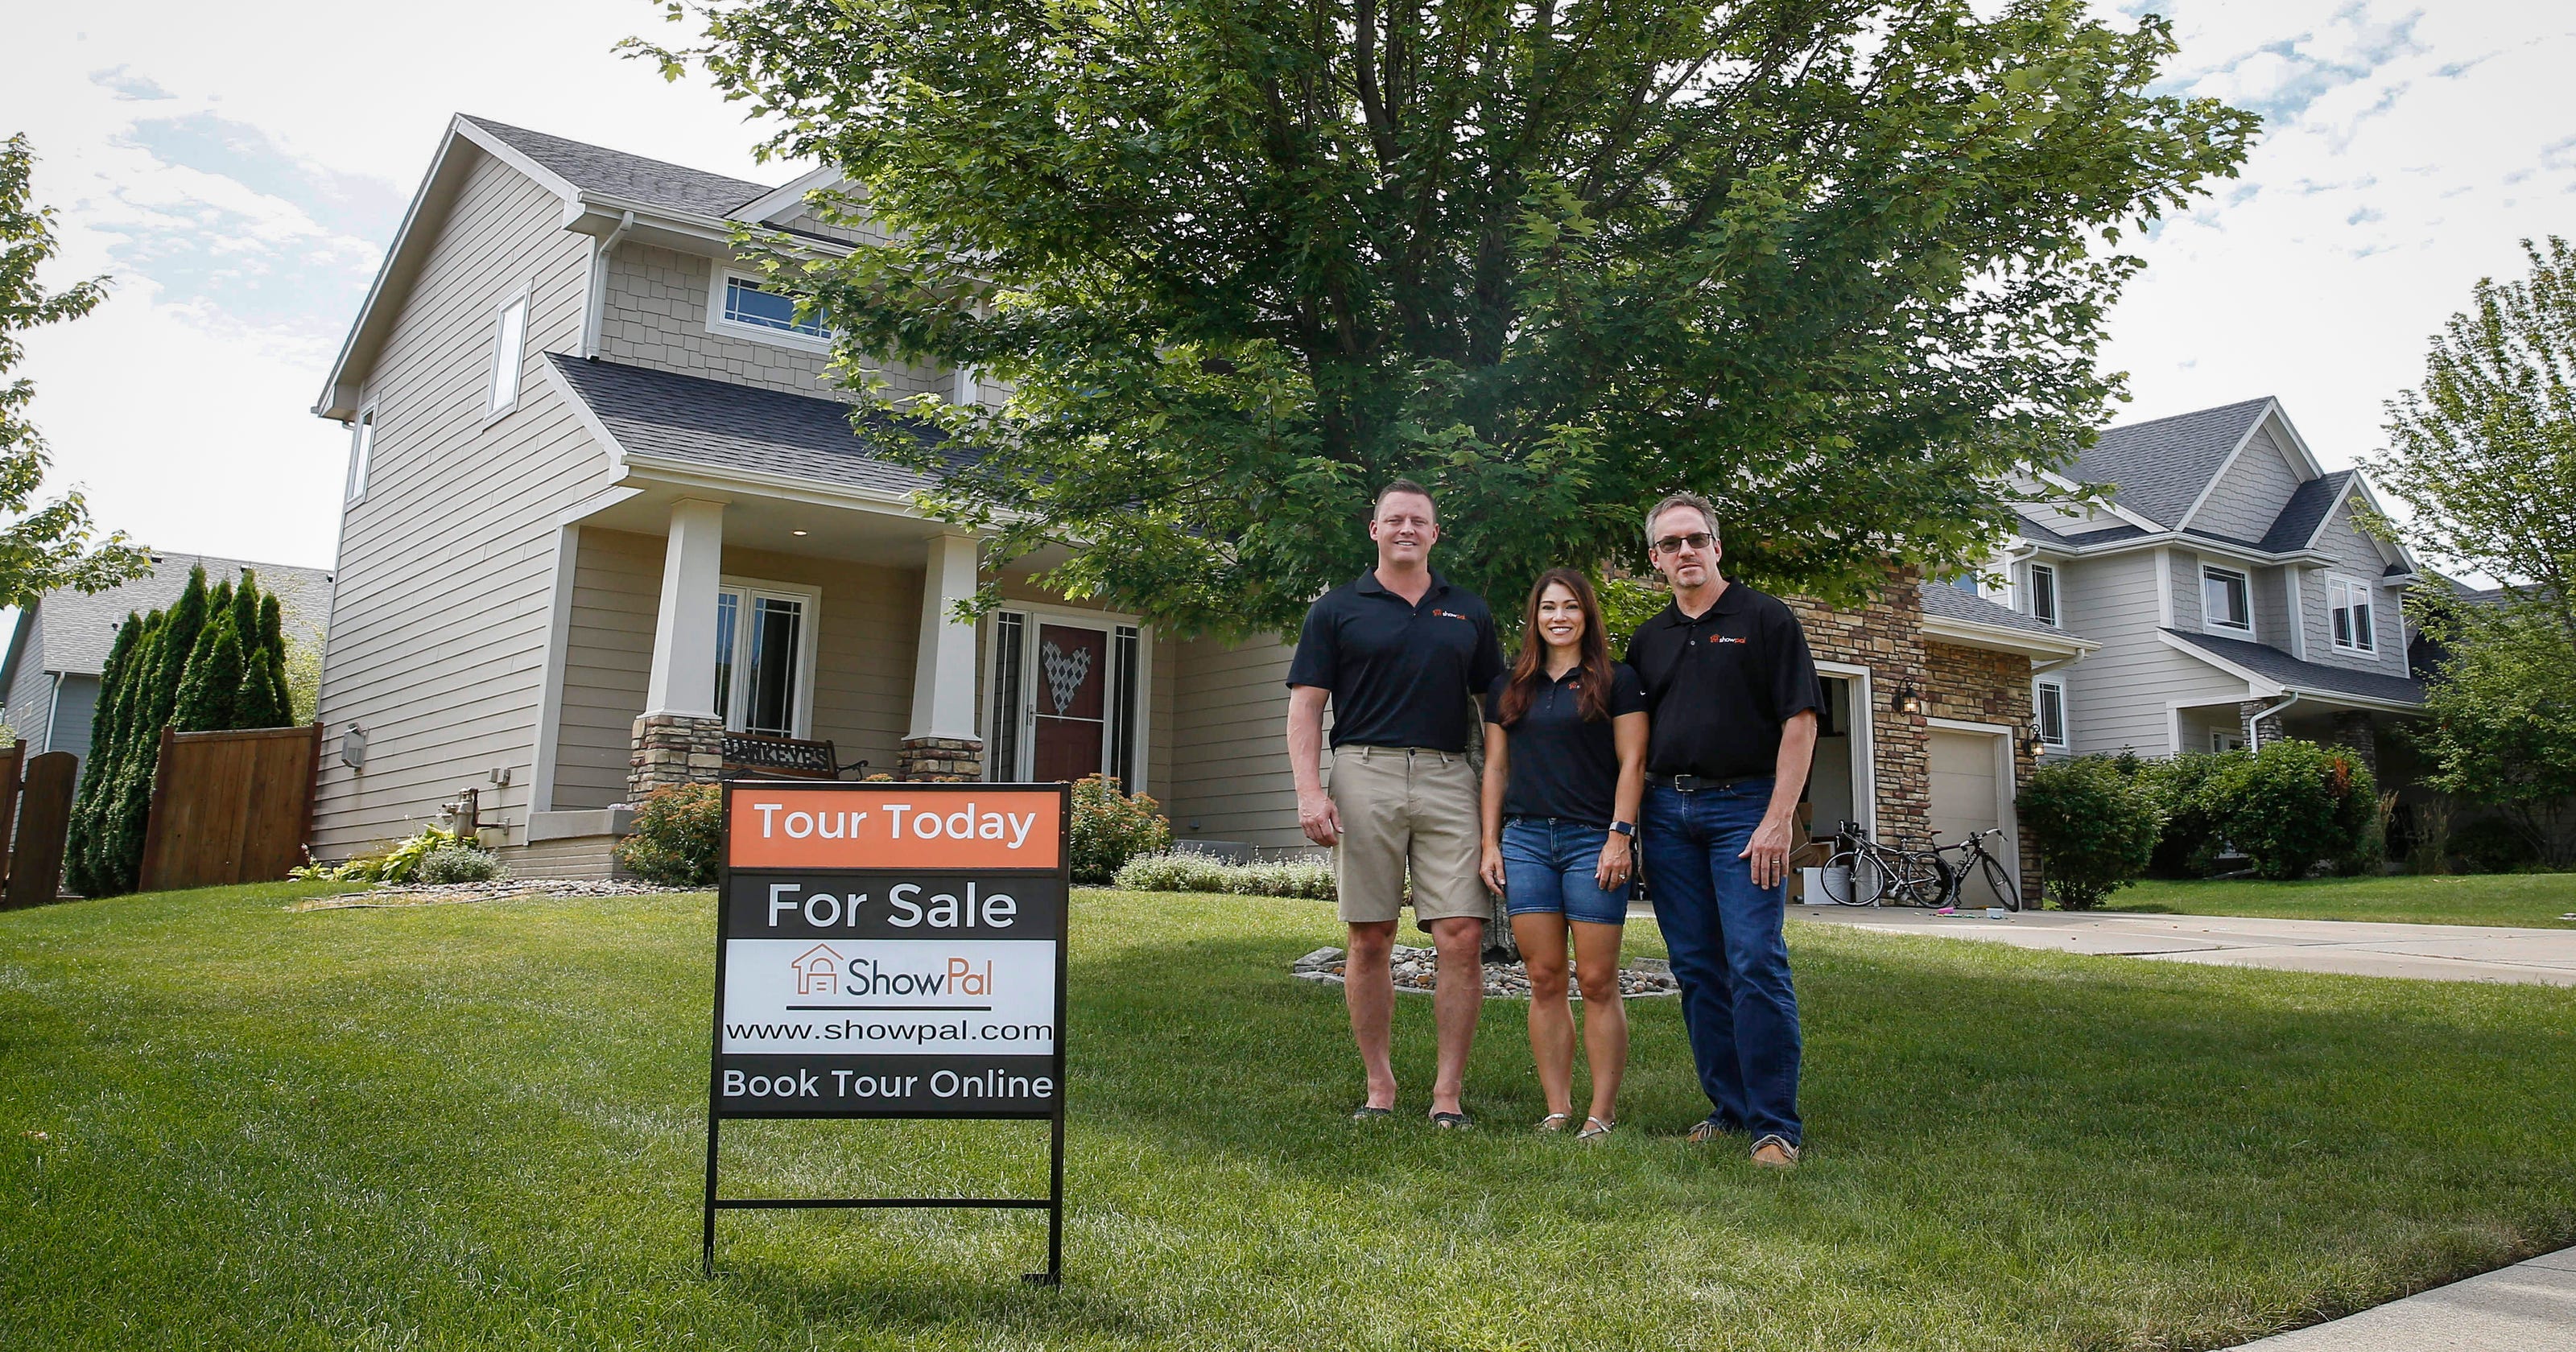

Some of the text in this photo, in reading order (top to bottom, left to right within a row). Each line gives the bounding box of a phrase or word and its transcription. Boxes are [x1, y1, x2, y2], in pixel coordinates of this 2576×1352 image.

[753, 802, 1036, 850] Tour Today
[768, 882, 1017, 929] For Sale
[846, 958, 993, 996] ShowPal
[725, 1020, 1053, 1045] www.showpal.com
[723, 1069, 1054, 1098] Book Tour Online
